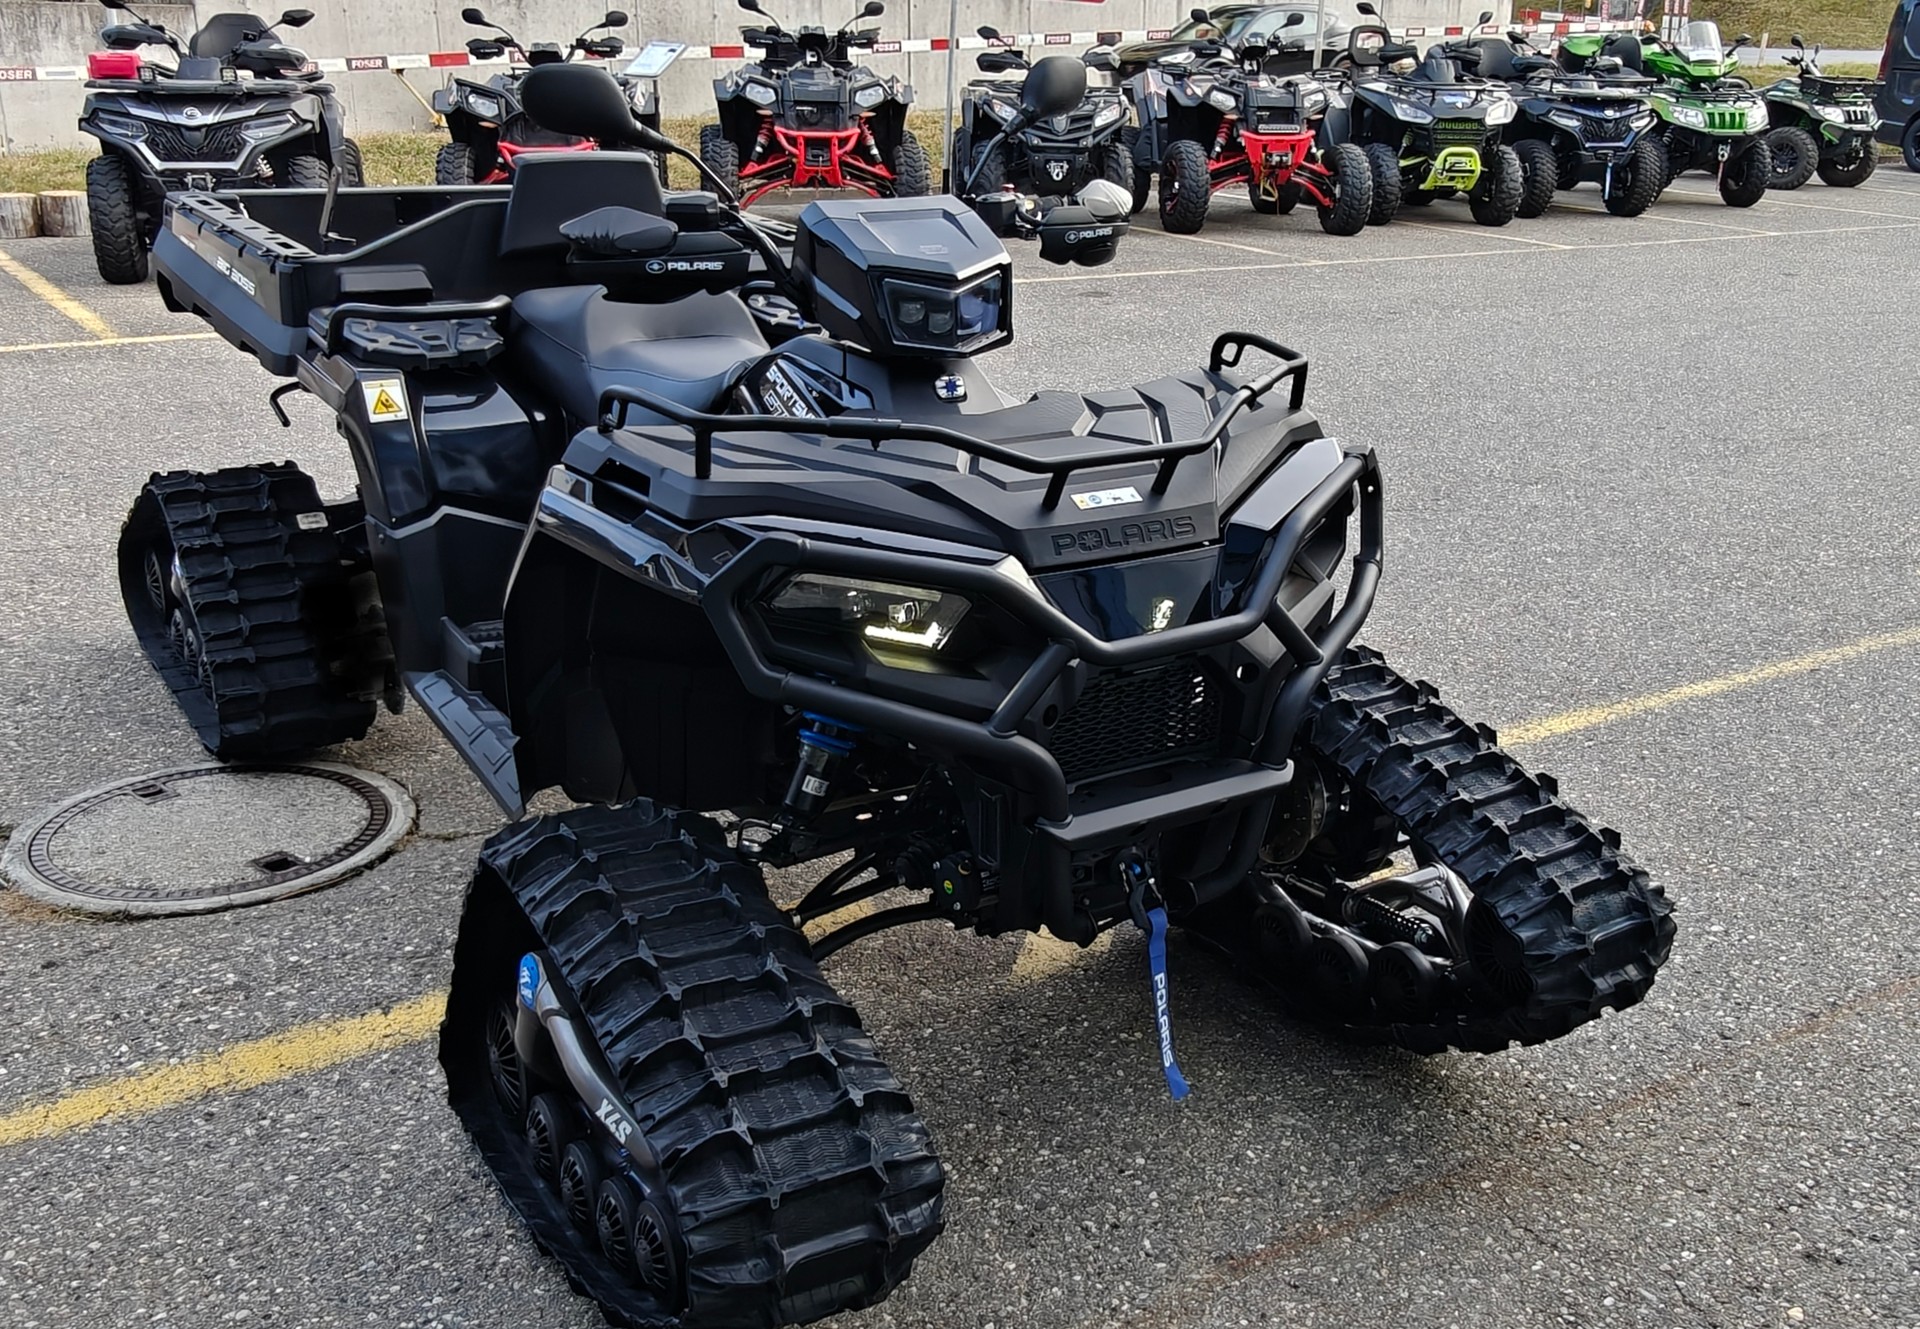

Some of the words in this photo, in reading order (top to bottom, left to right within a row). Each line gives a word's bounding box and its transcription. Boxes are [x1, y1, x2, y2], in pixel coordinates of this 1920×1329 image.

[873, 43, 900, 52] FOSER
[1046, 35, 1070, 44] FOSER
[351, 59, 383, 69] FOSER
[1079, 226, 1113, 239] POLARIS
[667, 261, 725, 271] POLARIS
[231, 267, 256, 296] BOSS
[763, 389, 790, 417] 57
[765, 364, 816, 418] SPORTSM
[1051, 516, 1197, 556] POLARIS
[1154, 972, 1174, 1067] POLARIS
[595, 1098, 632, 1144] X4S
